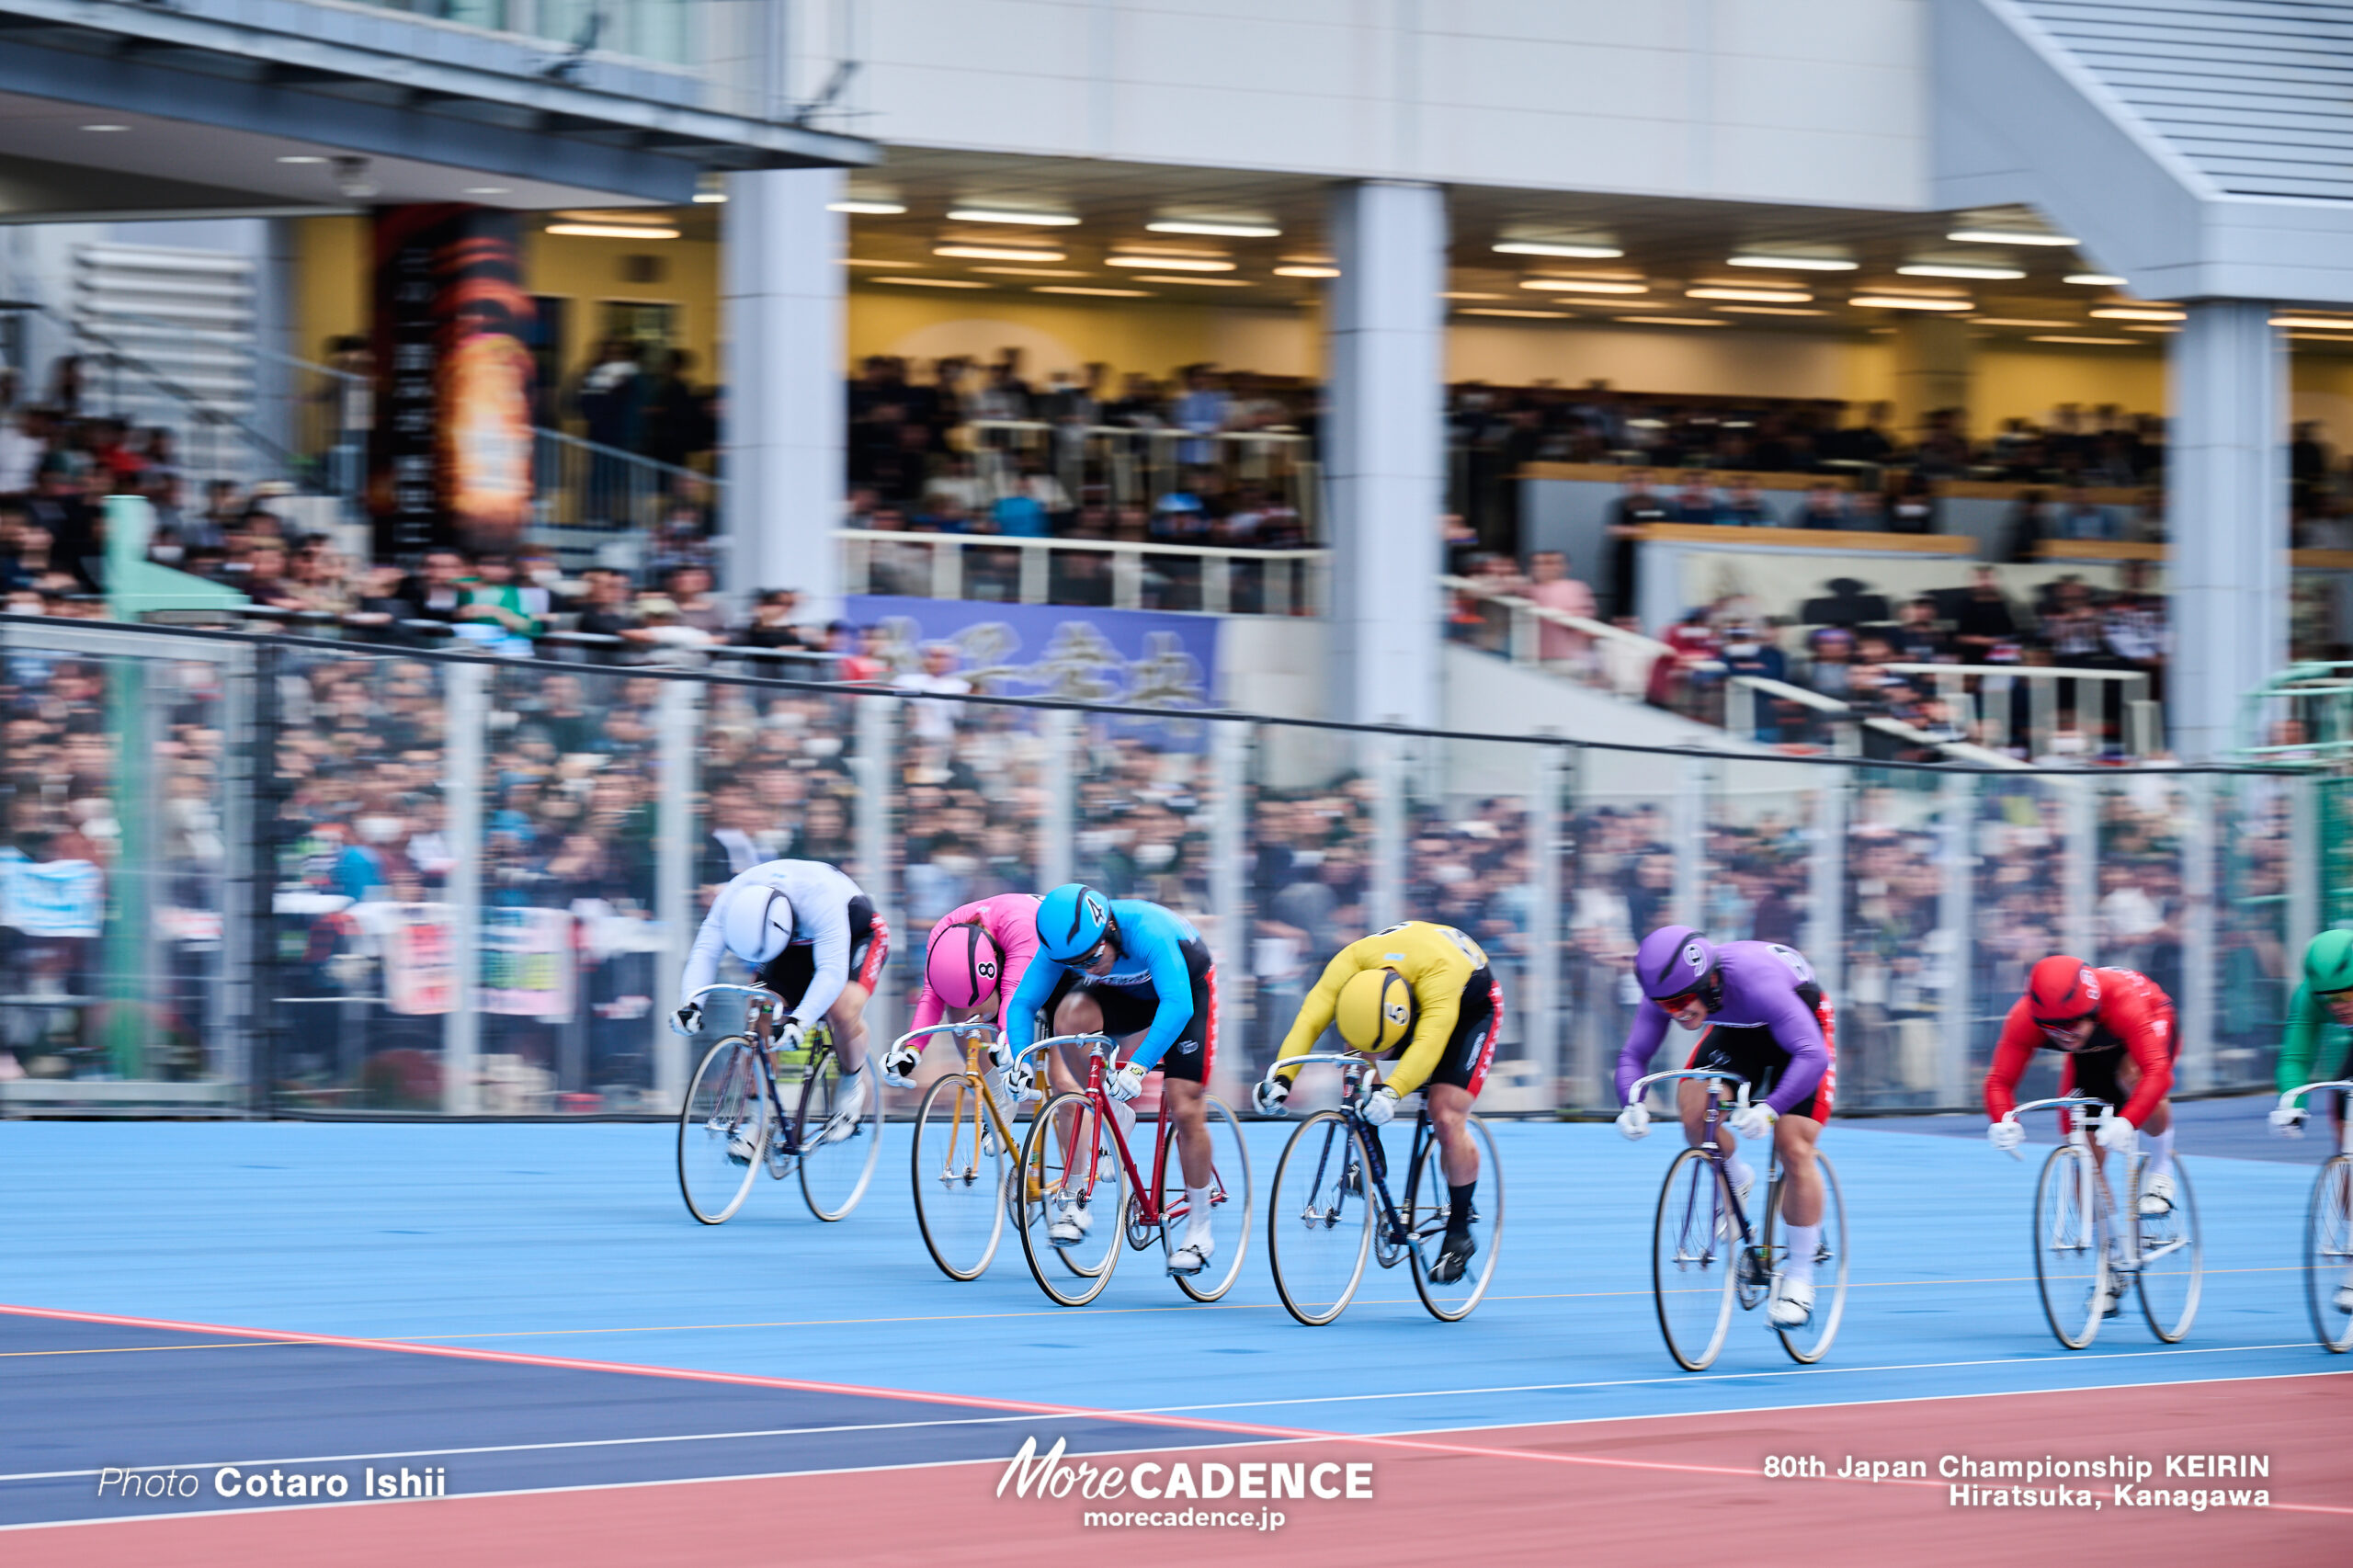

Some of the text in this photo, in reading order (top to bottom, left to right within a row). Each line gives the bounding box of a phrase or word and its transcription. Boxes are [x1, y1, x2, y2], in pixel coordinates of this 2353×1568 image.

[1086, 895, 1107, 927] 4
[977, 961, 997, 980] 8
[1683, 943, 1707, 977] 9
[1384, 1002, 1409, 1026] 5
